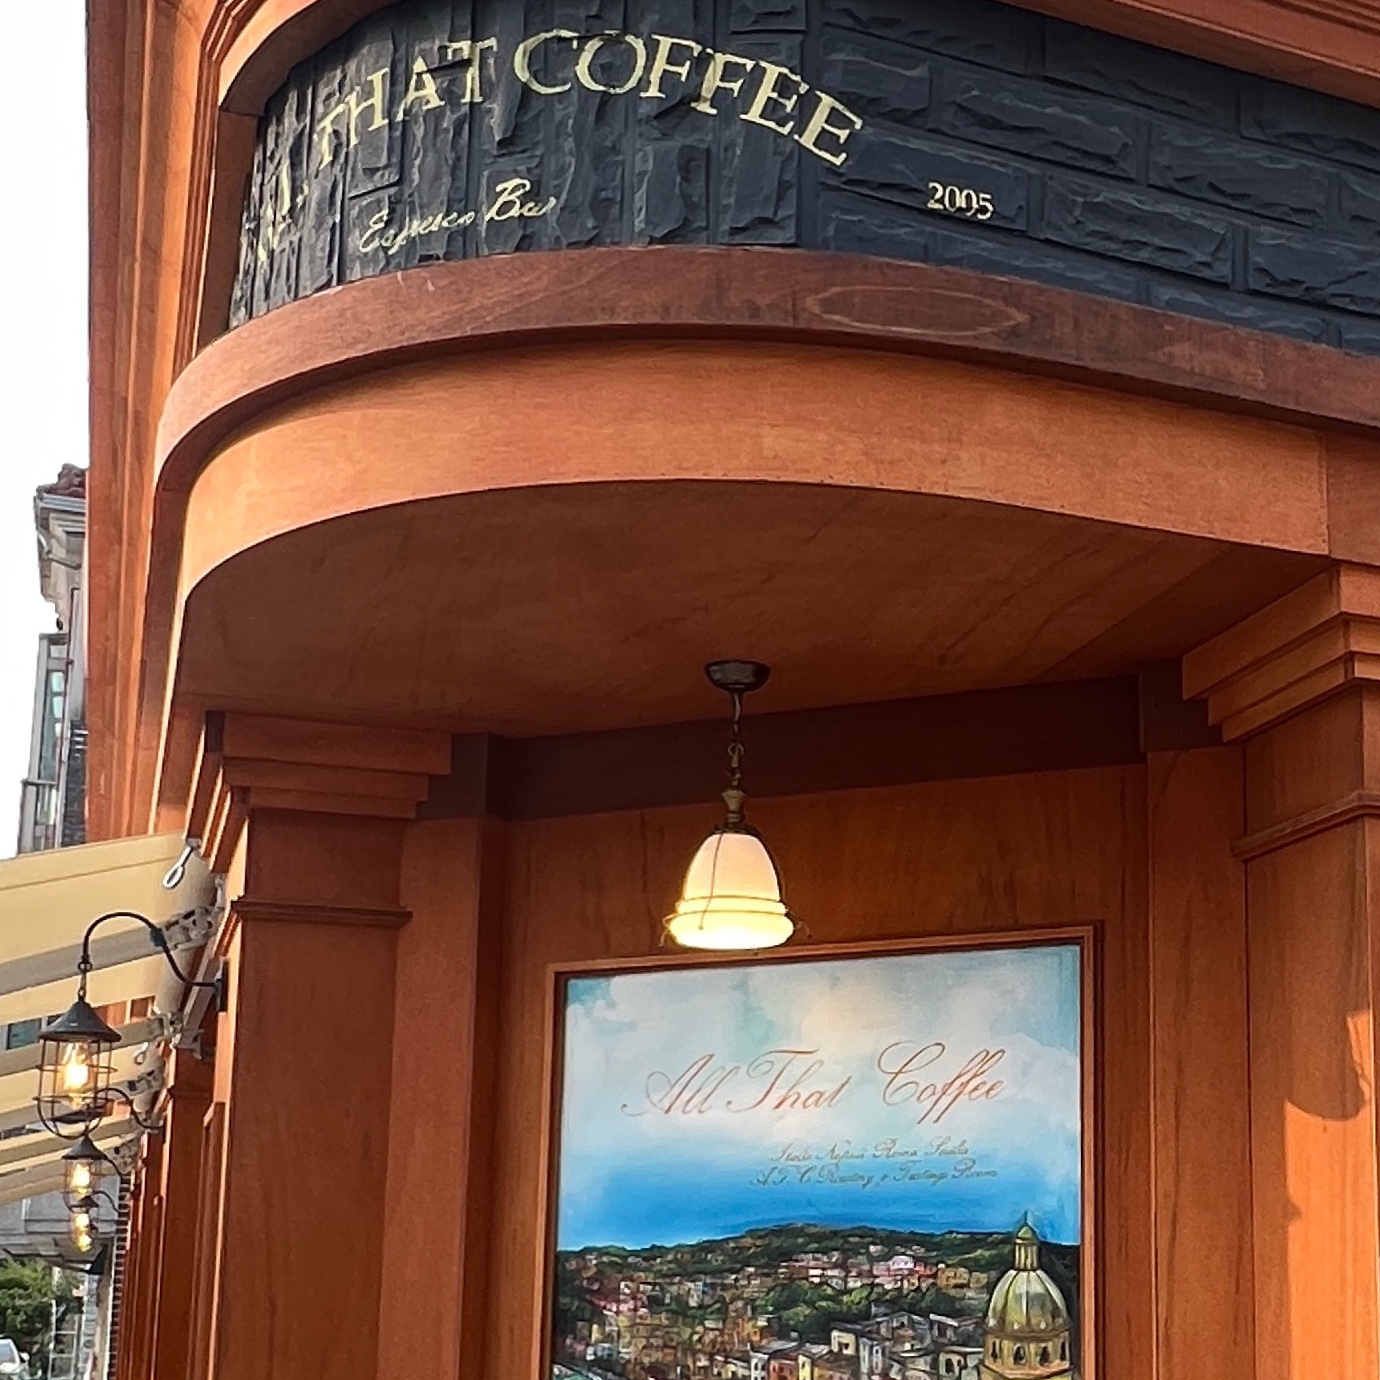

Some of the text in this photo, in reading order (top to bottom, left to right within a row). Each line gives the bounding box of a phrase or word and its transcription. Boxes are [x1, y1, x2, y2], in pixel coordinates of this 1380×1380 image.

[313, 36, 498, 171] THAT
[513, 28, 864, 166] COFFEE
[926, 181, 995, 220] 2005
[620, 1039, 1007, 1126] All That Coffee
